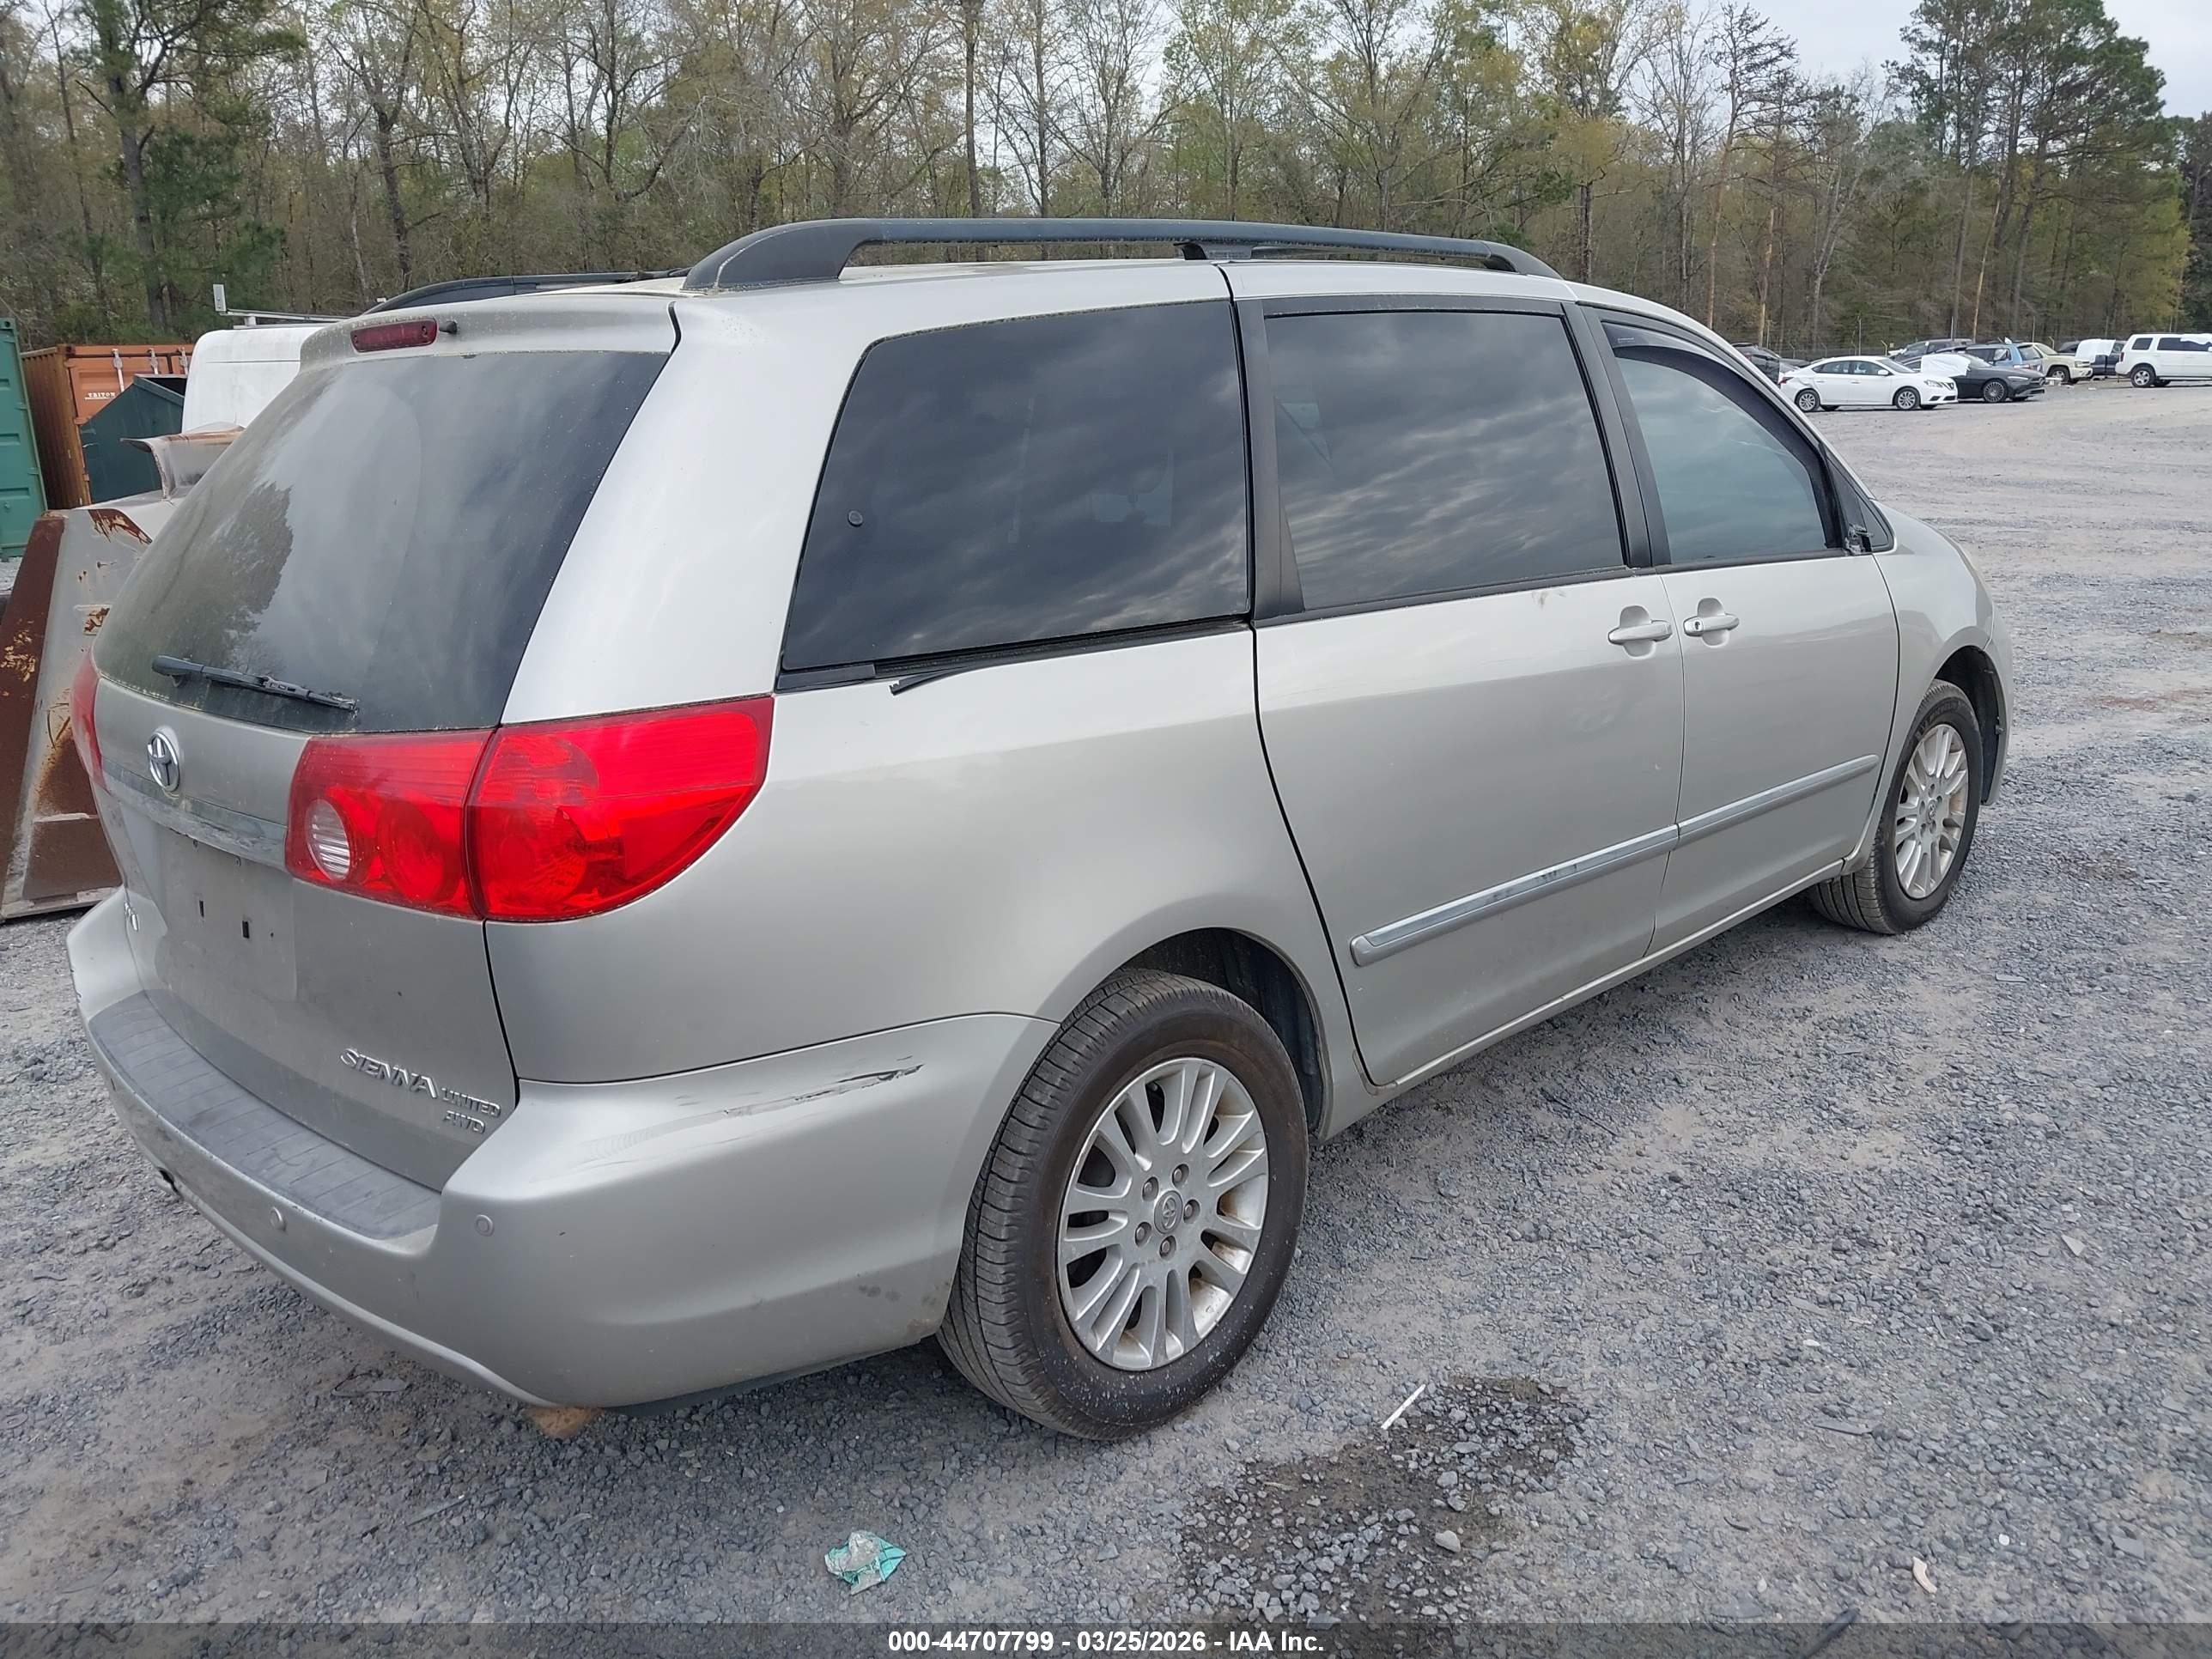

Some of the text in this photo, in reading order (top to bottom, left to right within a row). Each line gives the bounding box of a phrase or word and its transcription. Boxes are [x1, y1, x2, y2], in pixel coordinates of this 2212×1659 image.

[340, 1047, 501, 1117] SIENNA LIMITED
[443, 1109, 486, 1134] AWD
